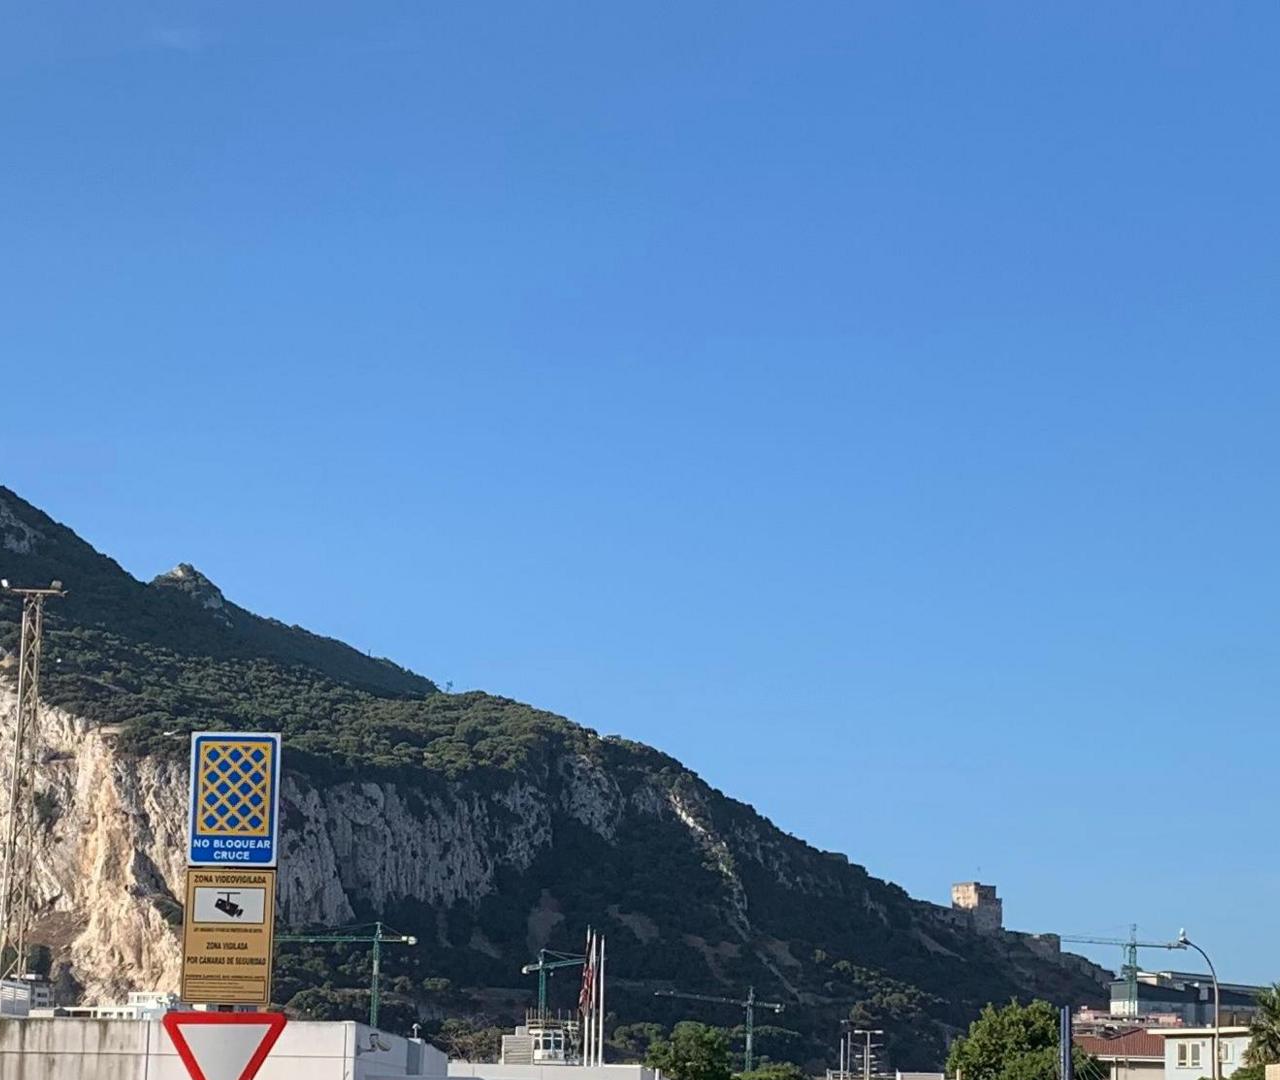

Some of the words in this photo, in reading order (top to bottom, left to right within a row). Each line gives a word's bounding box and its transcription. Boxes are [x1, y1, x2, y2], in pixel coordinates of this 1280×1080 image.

[192, 838, 210, 848] NO
[213, 839, 271, 849] BLOQUEAR
[213, 850, 250, 860] CRUCE
[194, 875, 213, 883] ZONA
